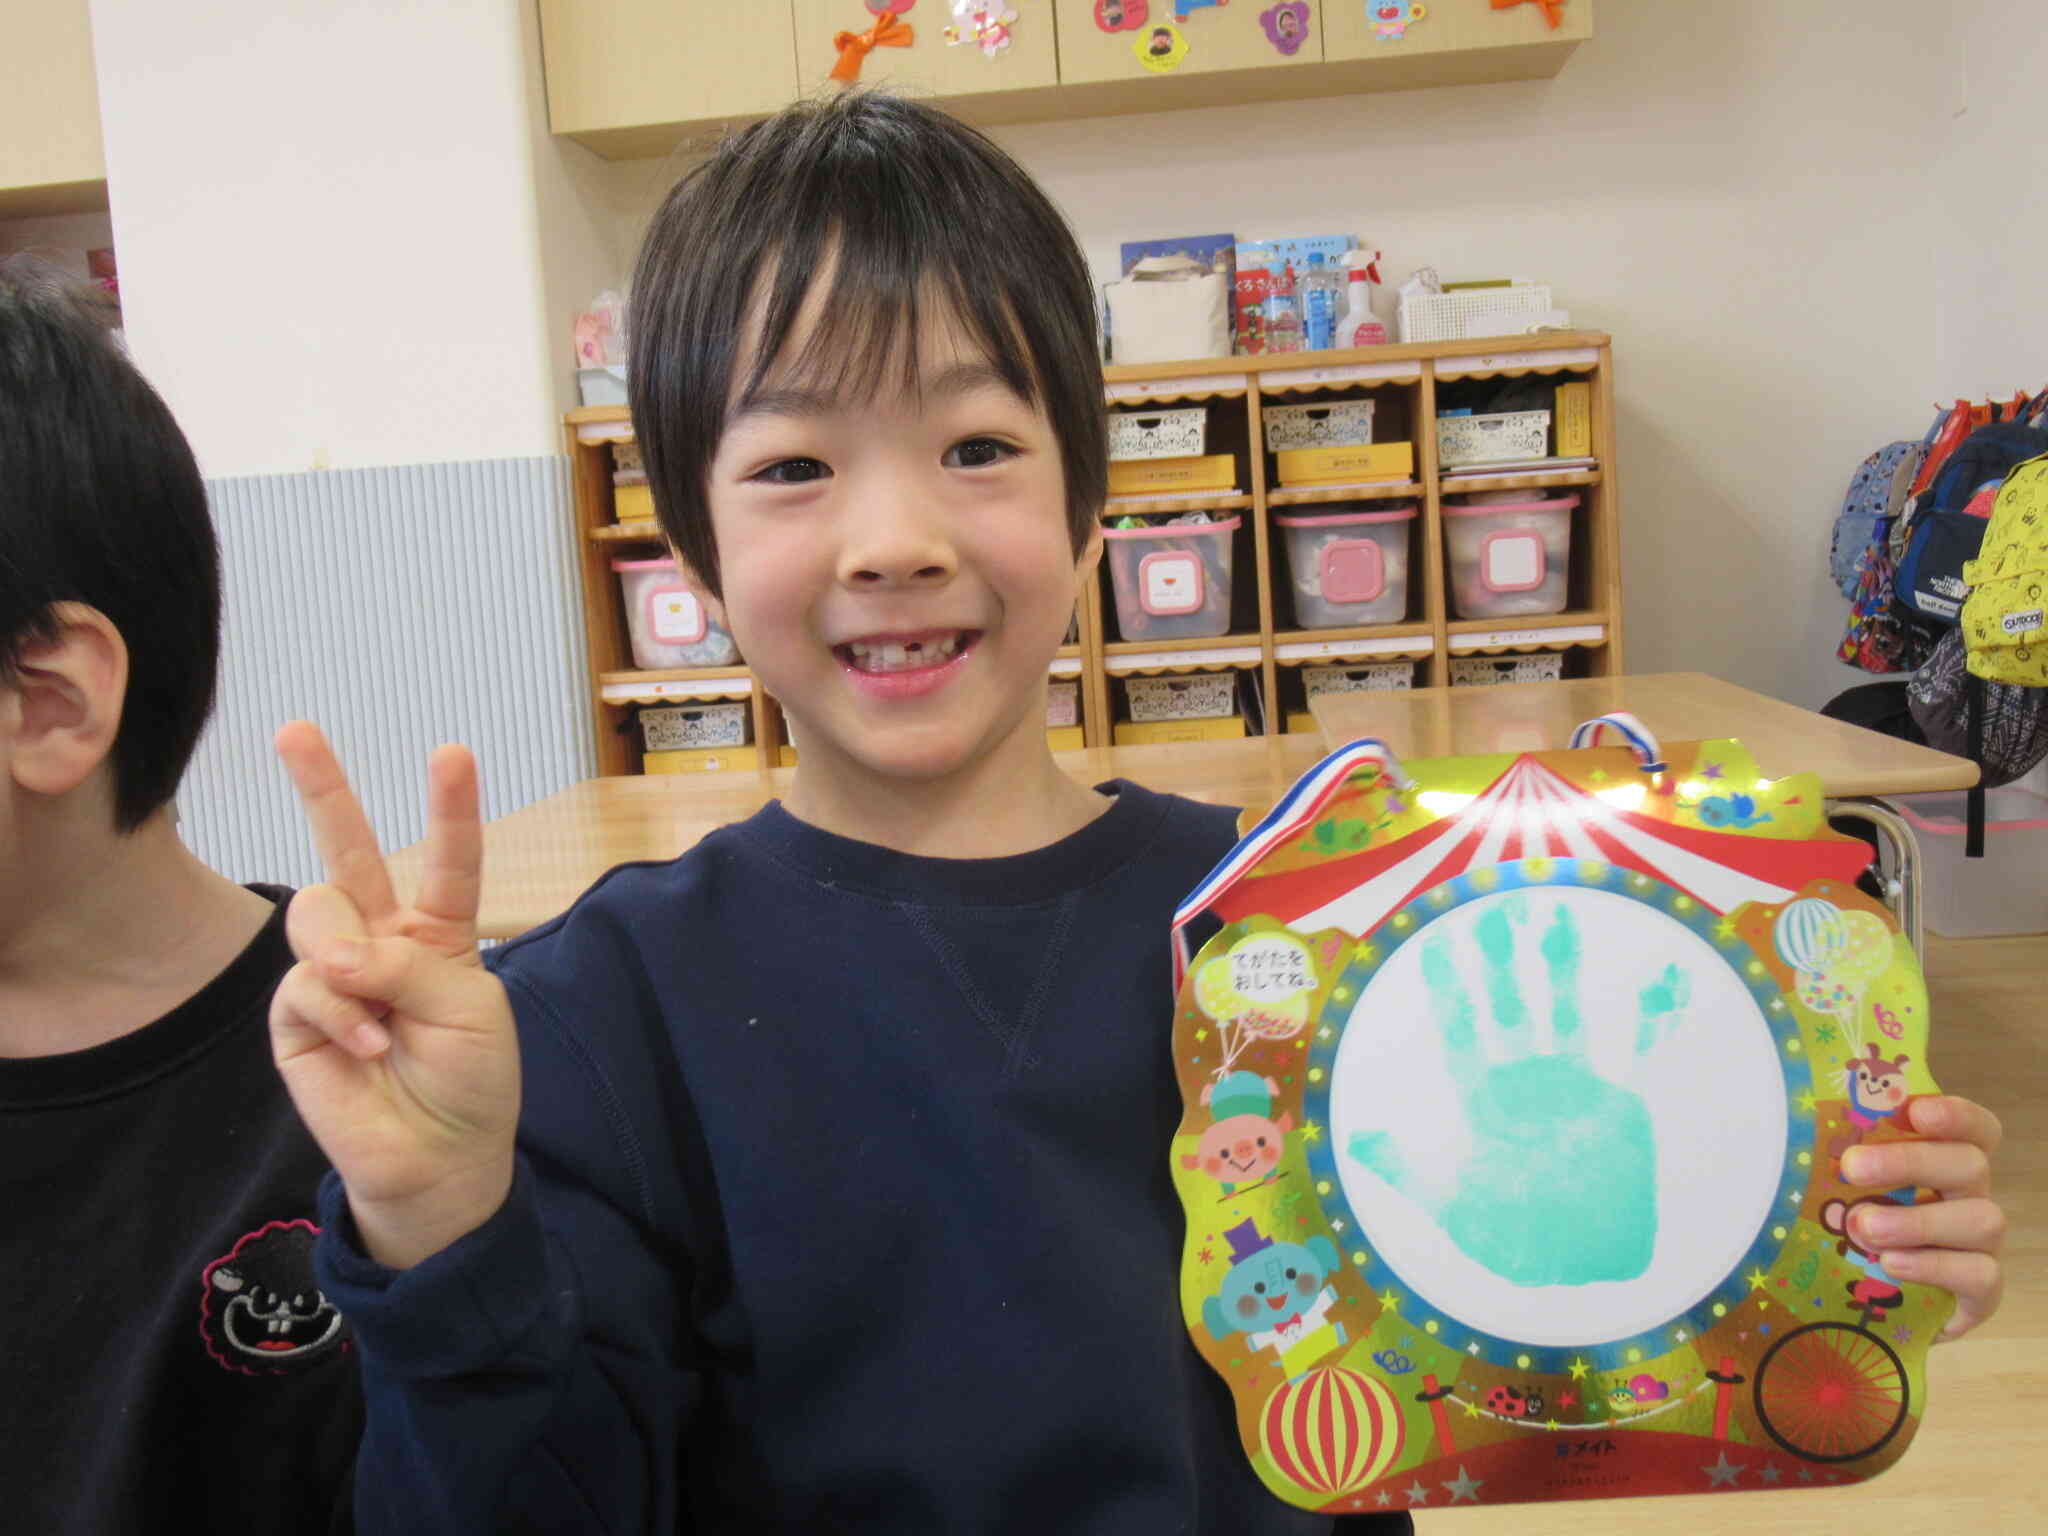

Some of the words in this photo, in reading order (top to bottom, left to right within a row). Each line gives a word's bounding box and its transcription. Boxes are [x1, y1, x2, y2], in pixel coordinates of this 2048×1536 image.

[1232, 949, 1304, 969] てがたを
[1233, 972, 1315, 991] おしてね。
[1574, 1439, 1617, 1457] メイト
